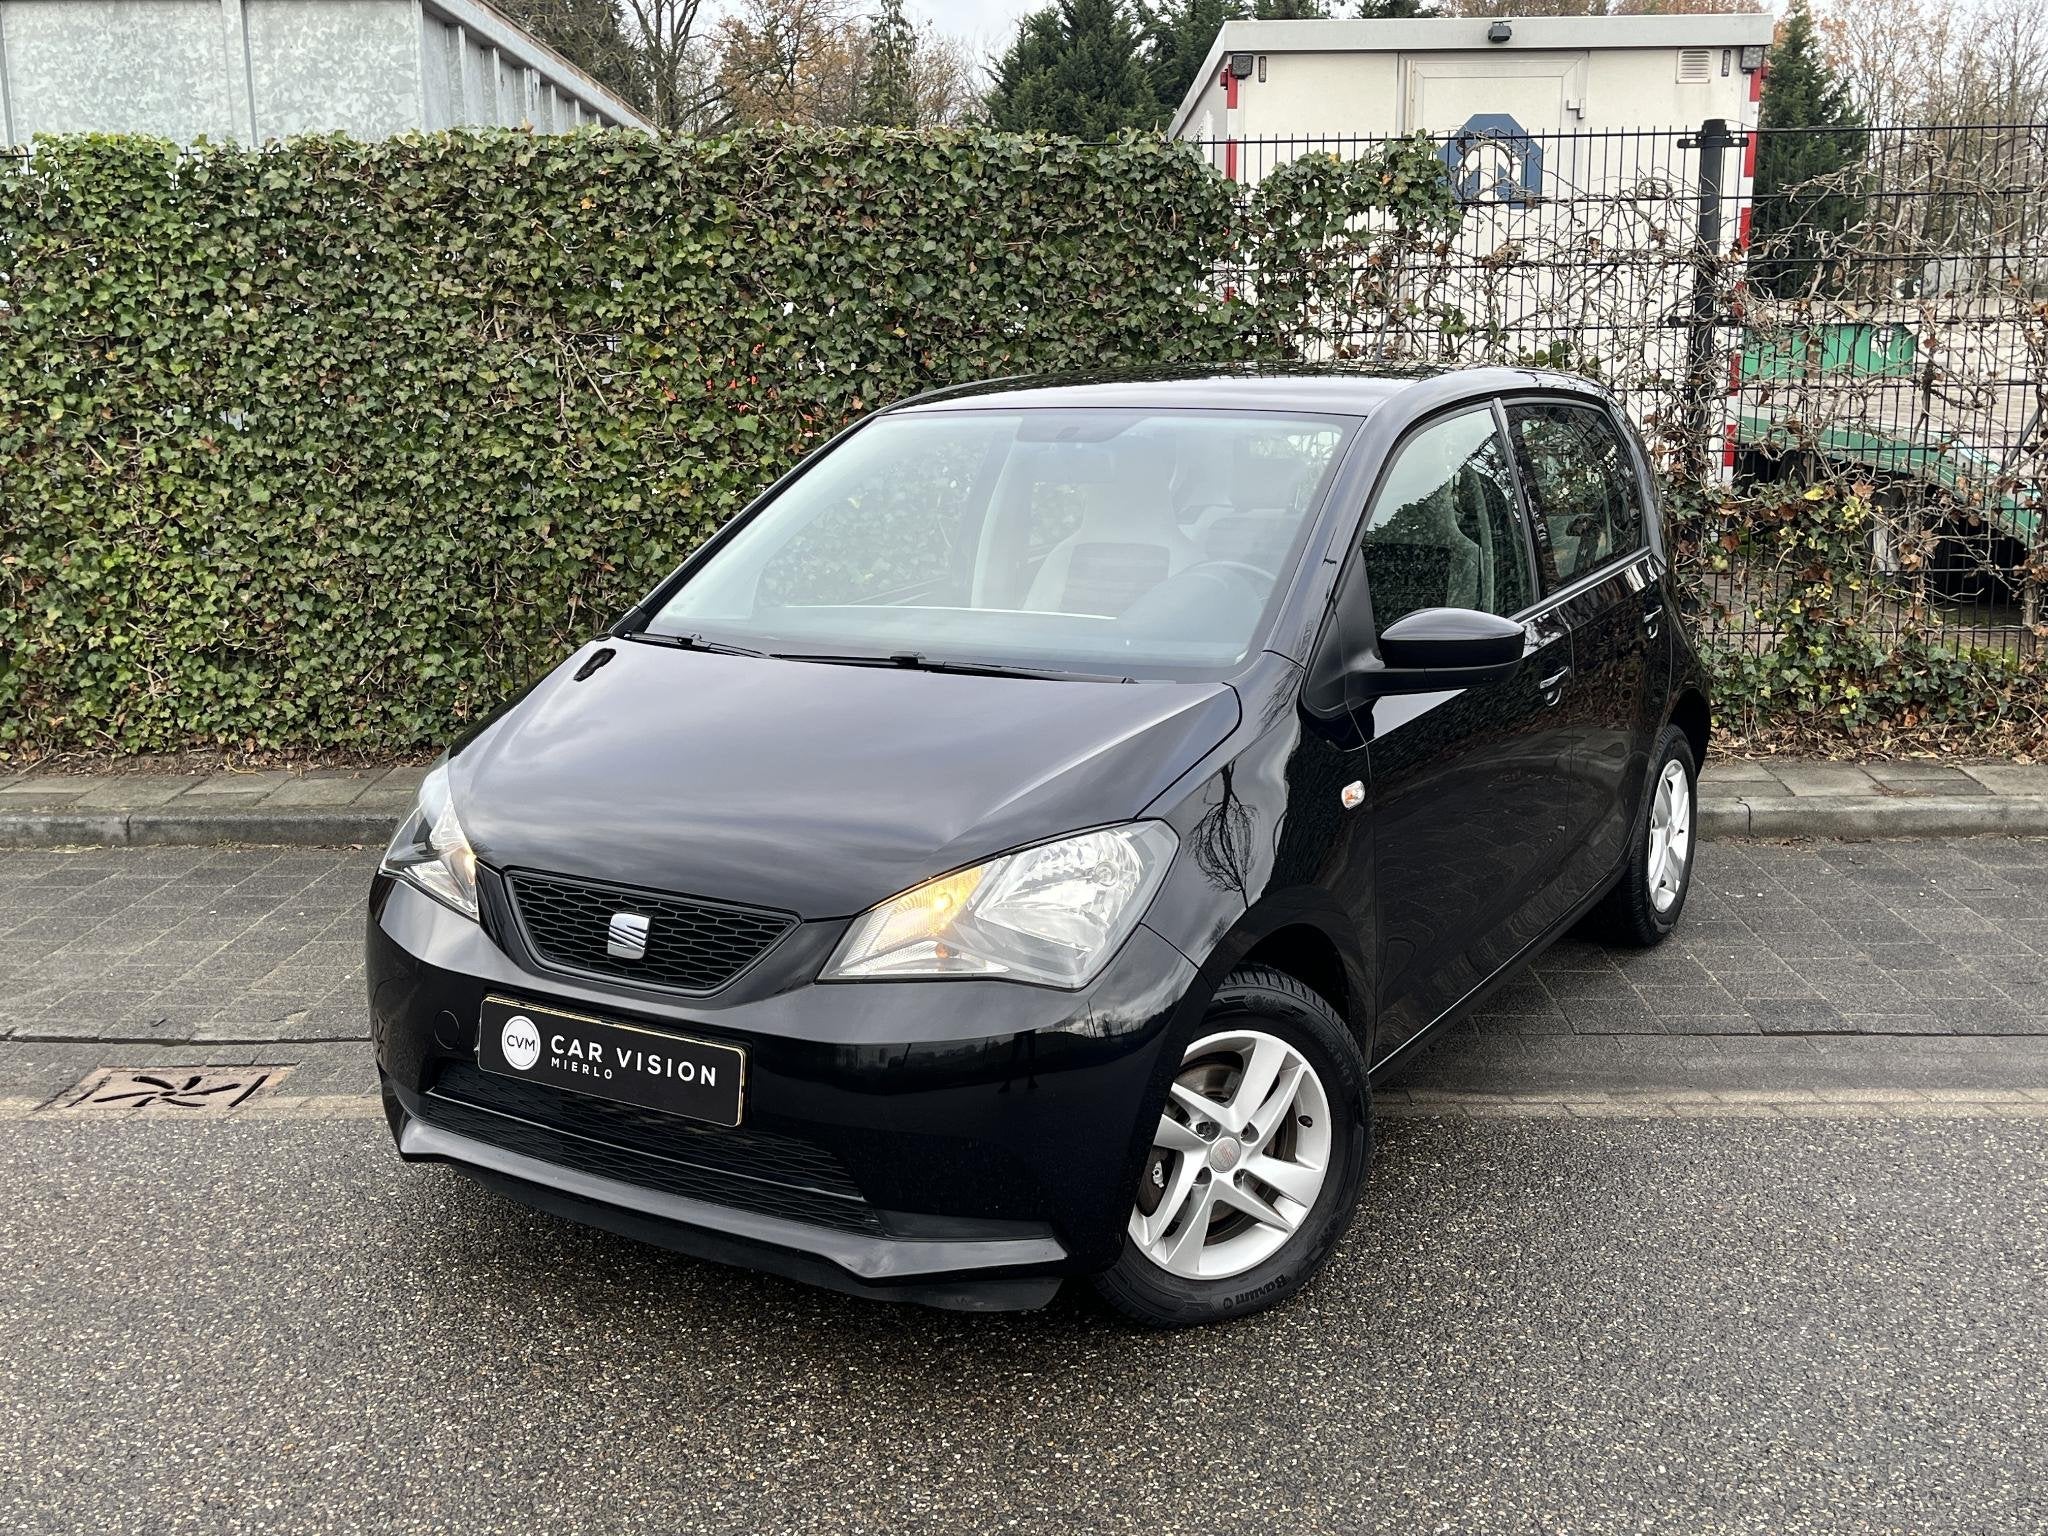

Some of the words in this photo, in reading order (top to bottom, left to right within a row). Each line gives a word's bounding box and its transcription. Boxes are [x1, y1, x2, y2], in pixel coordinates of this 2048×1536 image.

[506, 1034, 536, 1052] CVM
[550, 1034, 602, 1063] CAR
[616, 1047, 716, 1087] VISION
[550, 1057, 613, 1080] MIERLO
